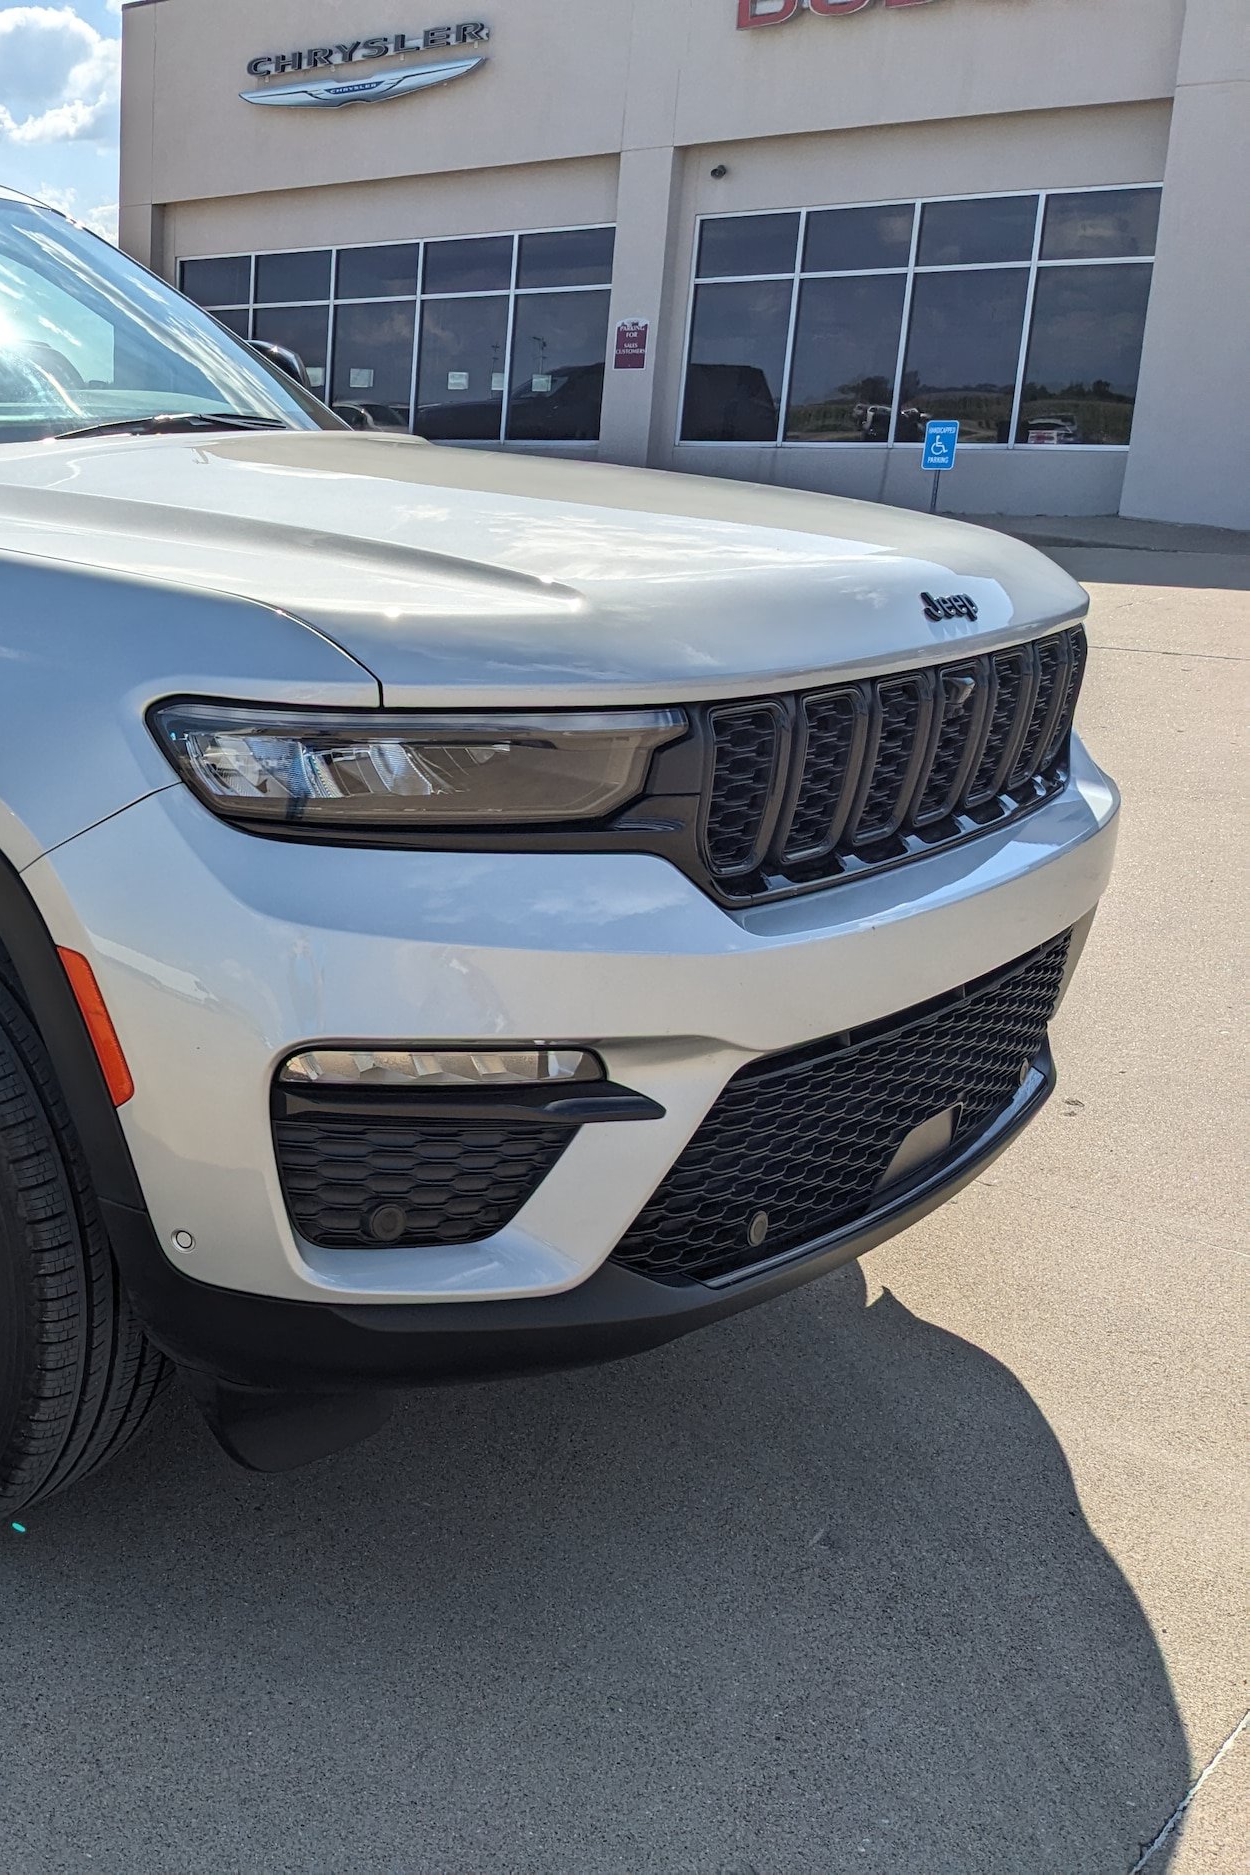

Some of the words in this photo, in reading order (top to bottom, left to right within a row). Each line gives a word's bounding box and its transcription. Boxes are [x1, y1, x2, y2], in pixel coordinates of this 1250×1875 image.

[247, 21, 487, 77] CHRYSLER
[330, 83, 377, 94] CHRYSLER
[920, 591, 979, 622] Jeep
